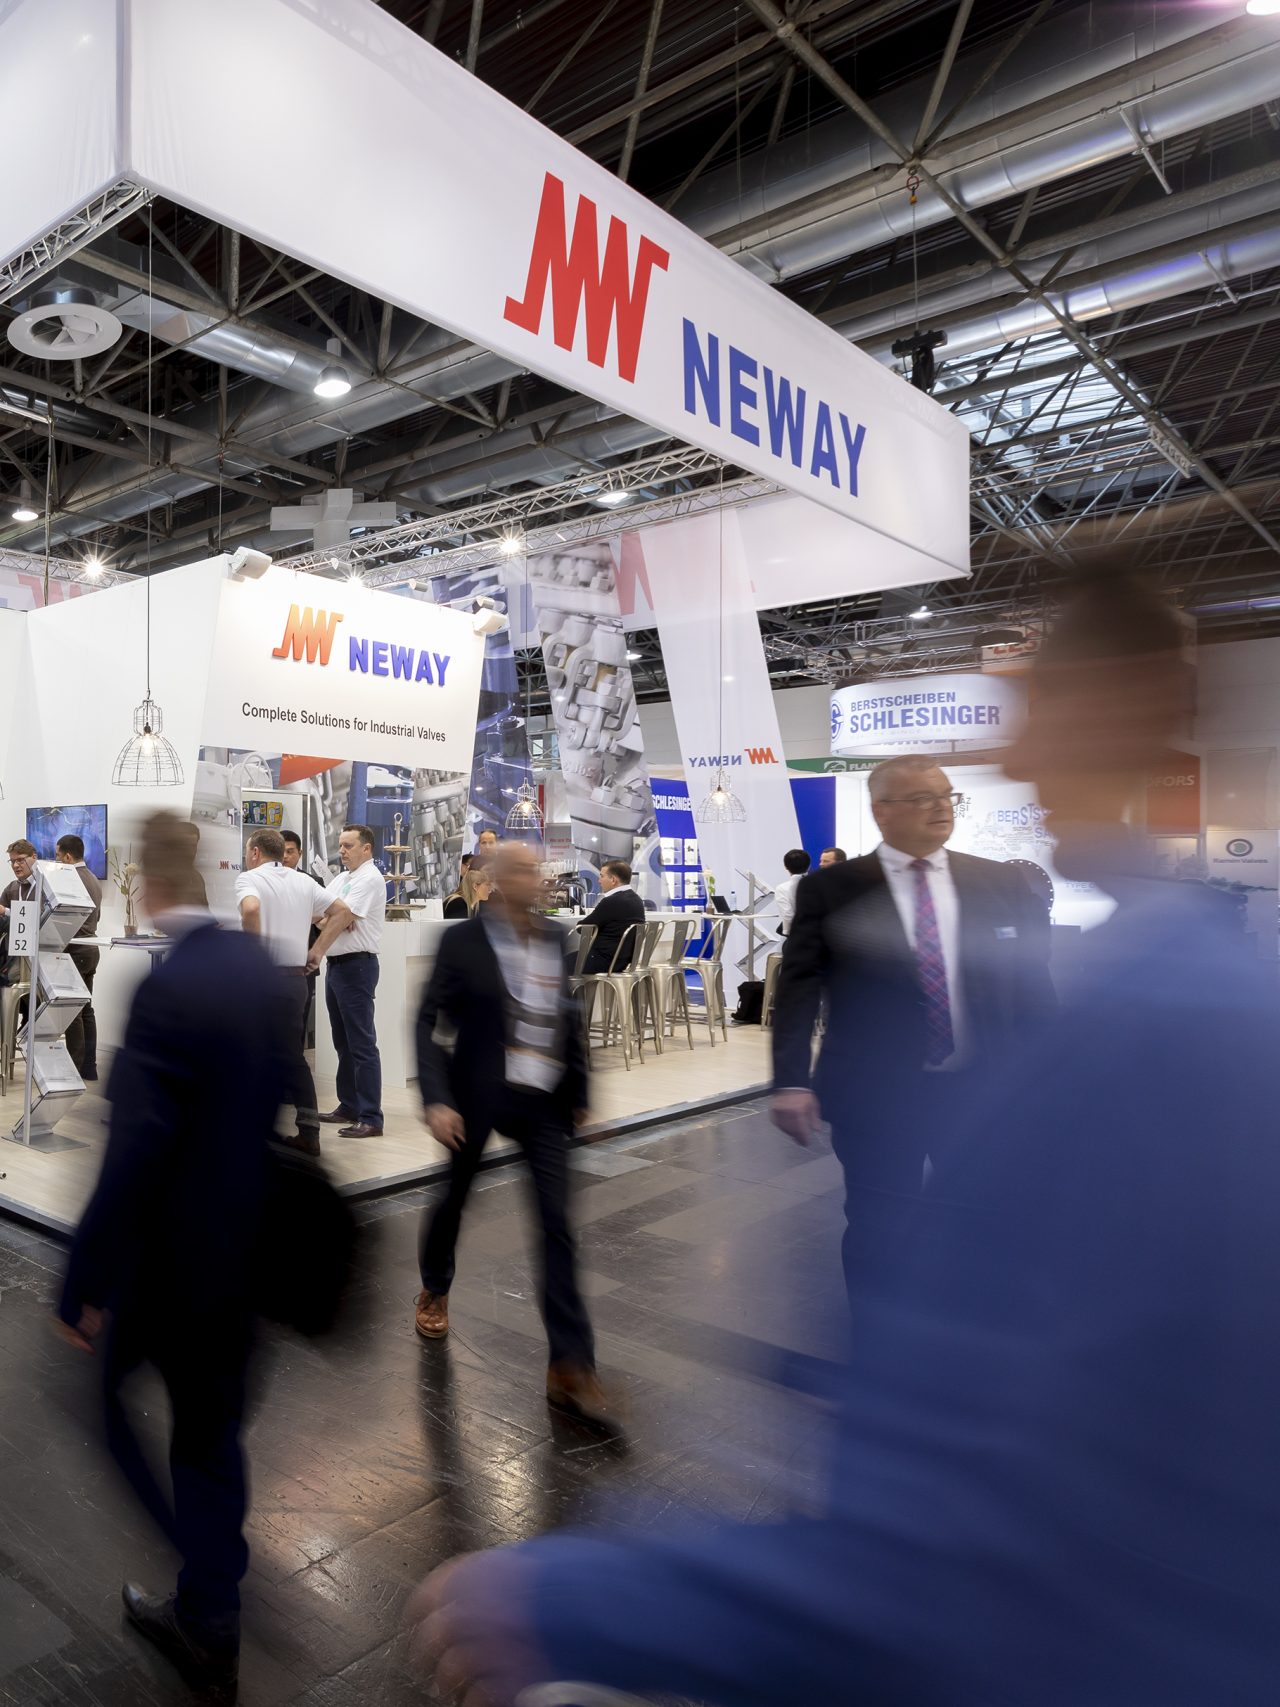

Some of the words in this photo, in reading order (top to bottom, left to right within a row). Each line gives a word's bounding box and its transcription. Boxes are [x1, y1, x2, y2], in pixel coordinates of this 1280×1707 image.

[682, 316, 867, 498] NEWAY
[349, 636, 450, 687] NEWAY
[851, 692, 956, 712] BERSTSCHEIBEN
[242, 702, 297, 723] Complete
[300, 710, 350, 730] Solutions
[354, 718, 368, 732] for
[370, 719, 415, 738] Industrial
[417, 727, 446, 742] Valves
[850, 705, 1000, 733] SCHLESINGER
[20, 906, 26, 917] 4
[18, 923, 25, 934] D
[15, 940, 27, 951] 52
